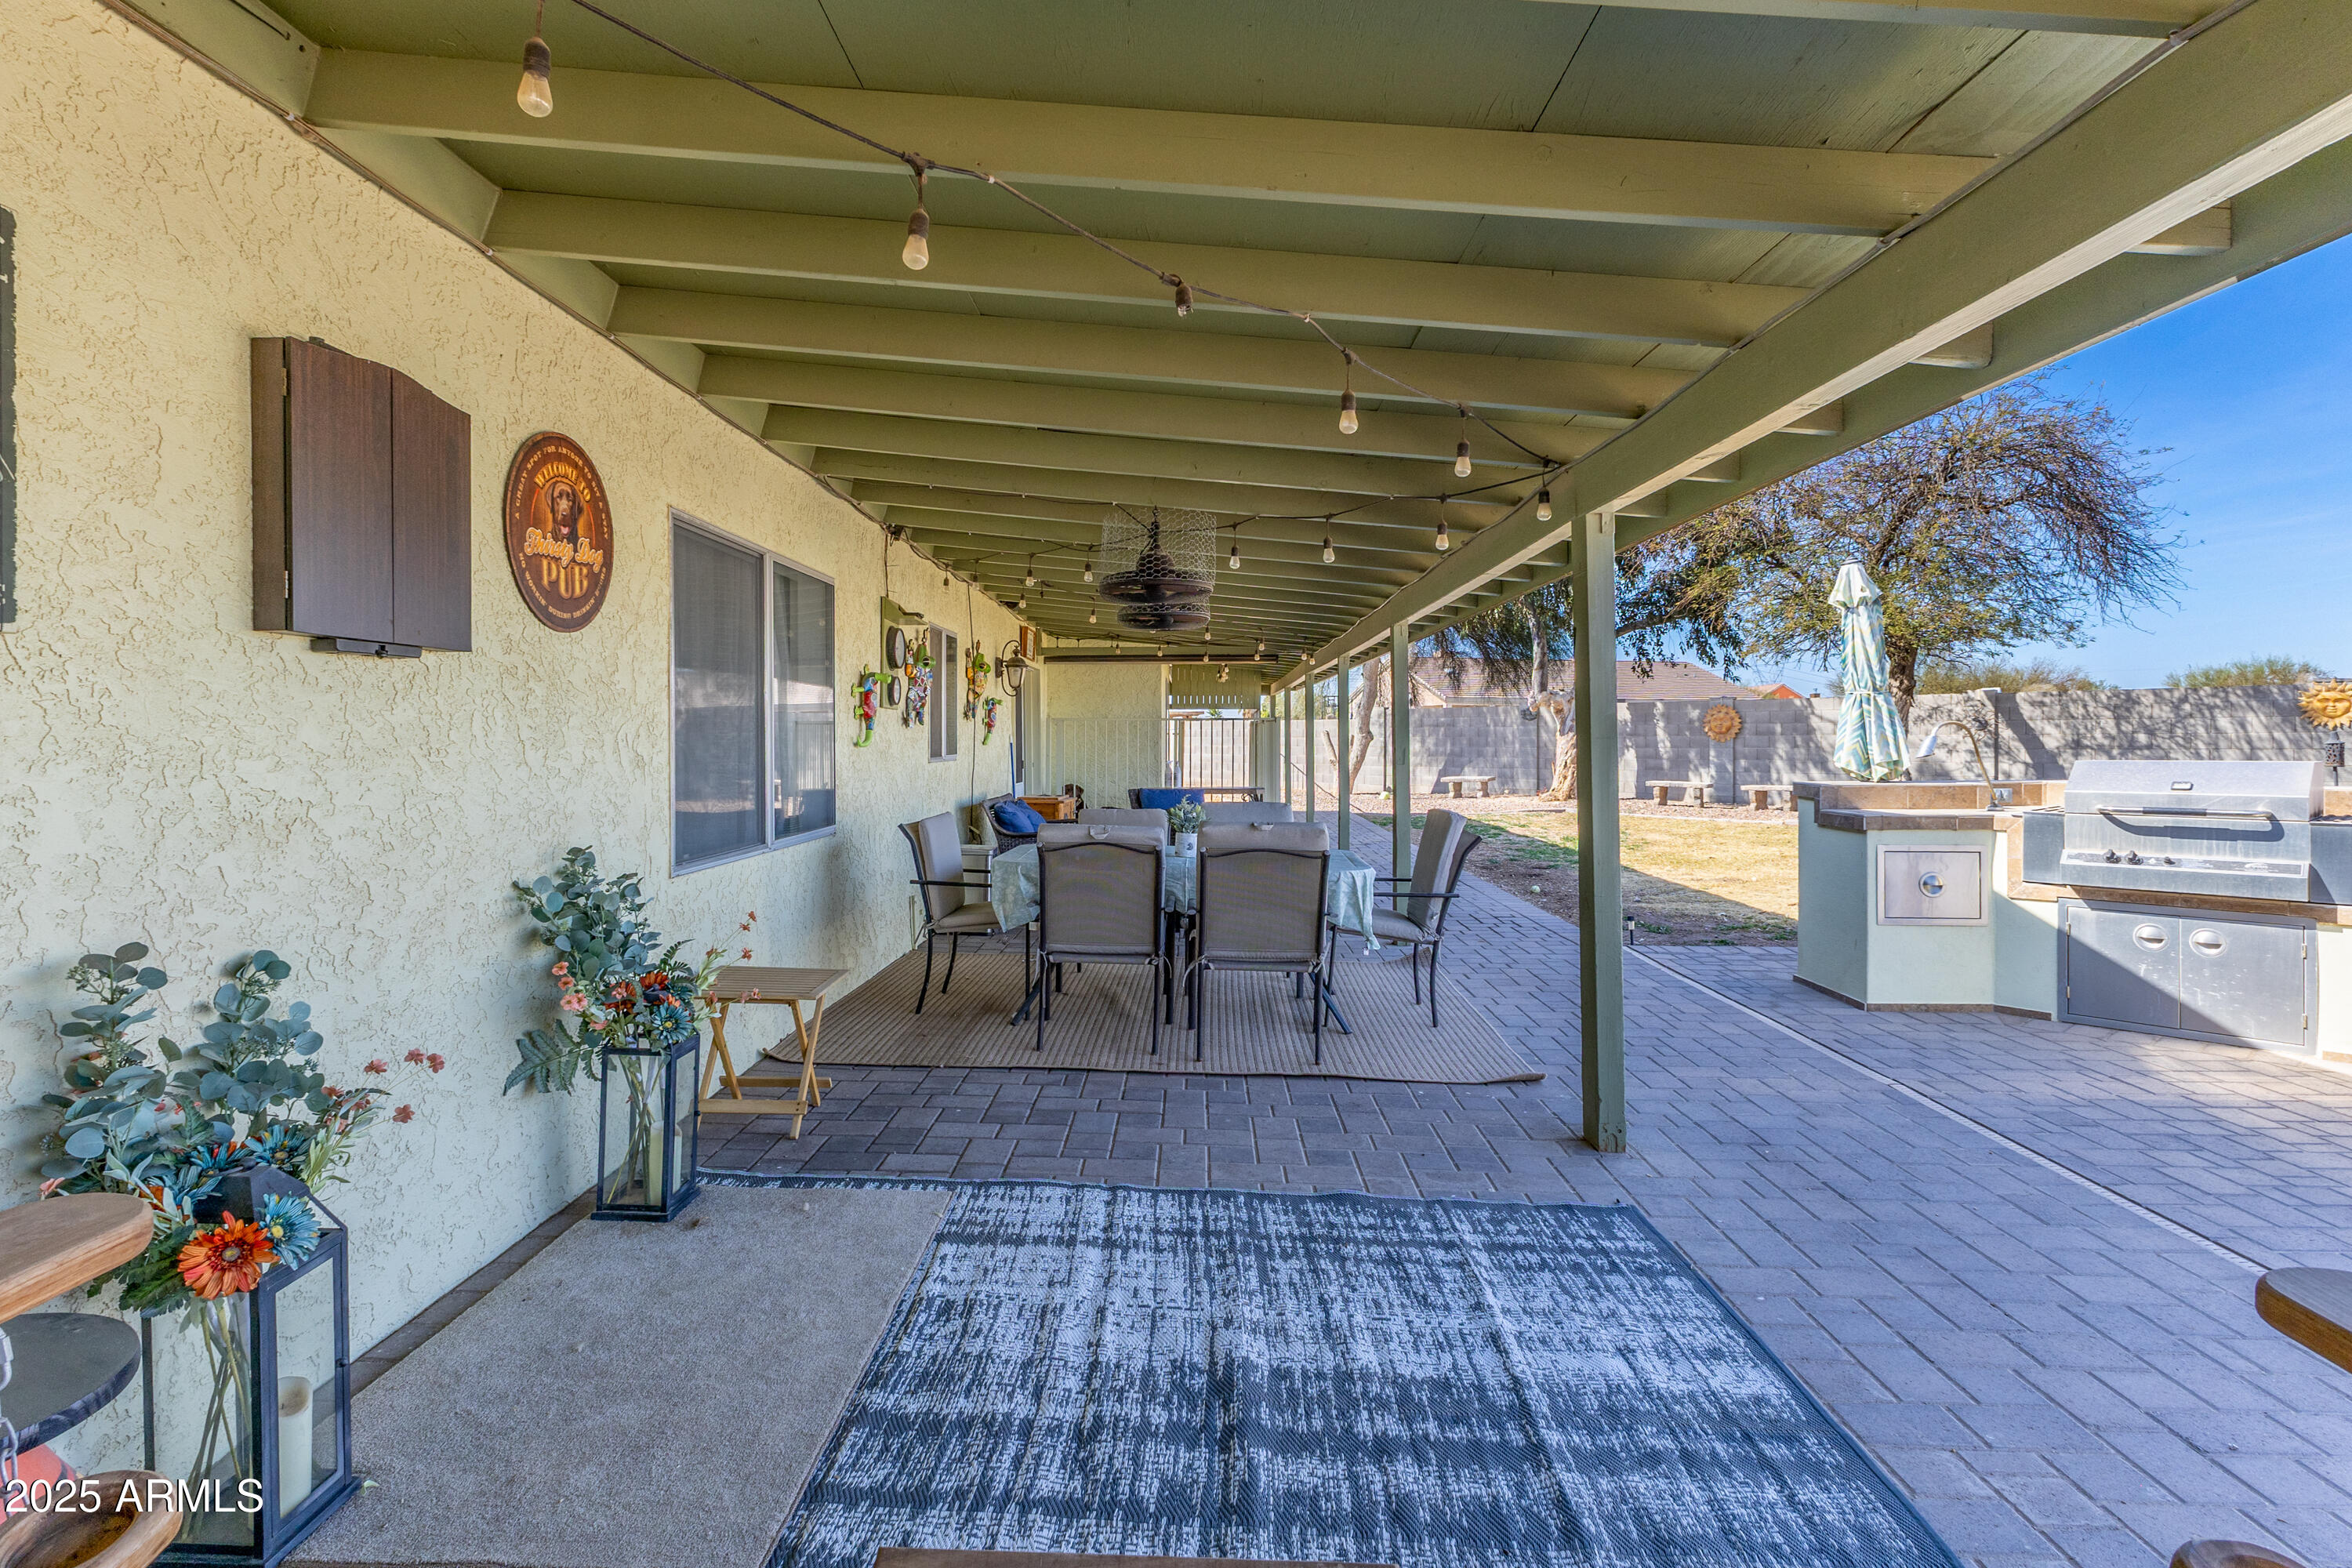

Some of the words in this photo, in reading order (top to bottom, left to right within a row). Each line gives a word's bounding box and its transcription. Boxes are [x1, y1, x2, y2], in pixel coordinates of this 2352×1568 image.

[527, 451, 542, 470] SPOT
[543, 445, 557, 455] FOR
[558, 446, 583, 466] ANYONE
[584, 466, 592, 479] TO
[534, 461, 579, 489] WELCOME
[578, 477, 591, 502] TO
[519, 552, 526, 568] NO
[524, 527, 574, 568] Thirsty
[575, 537, 604, 573] Dog
[541, 556, 589, 599] PUB
